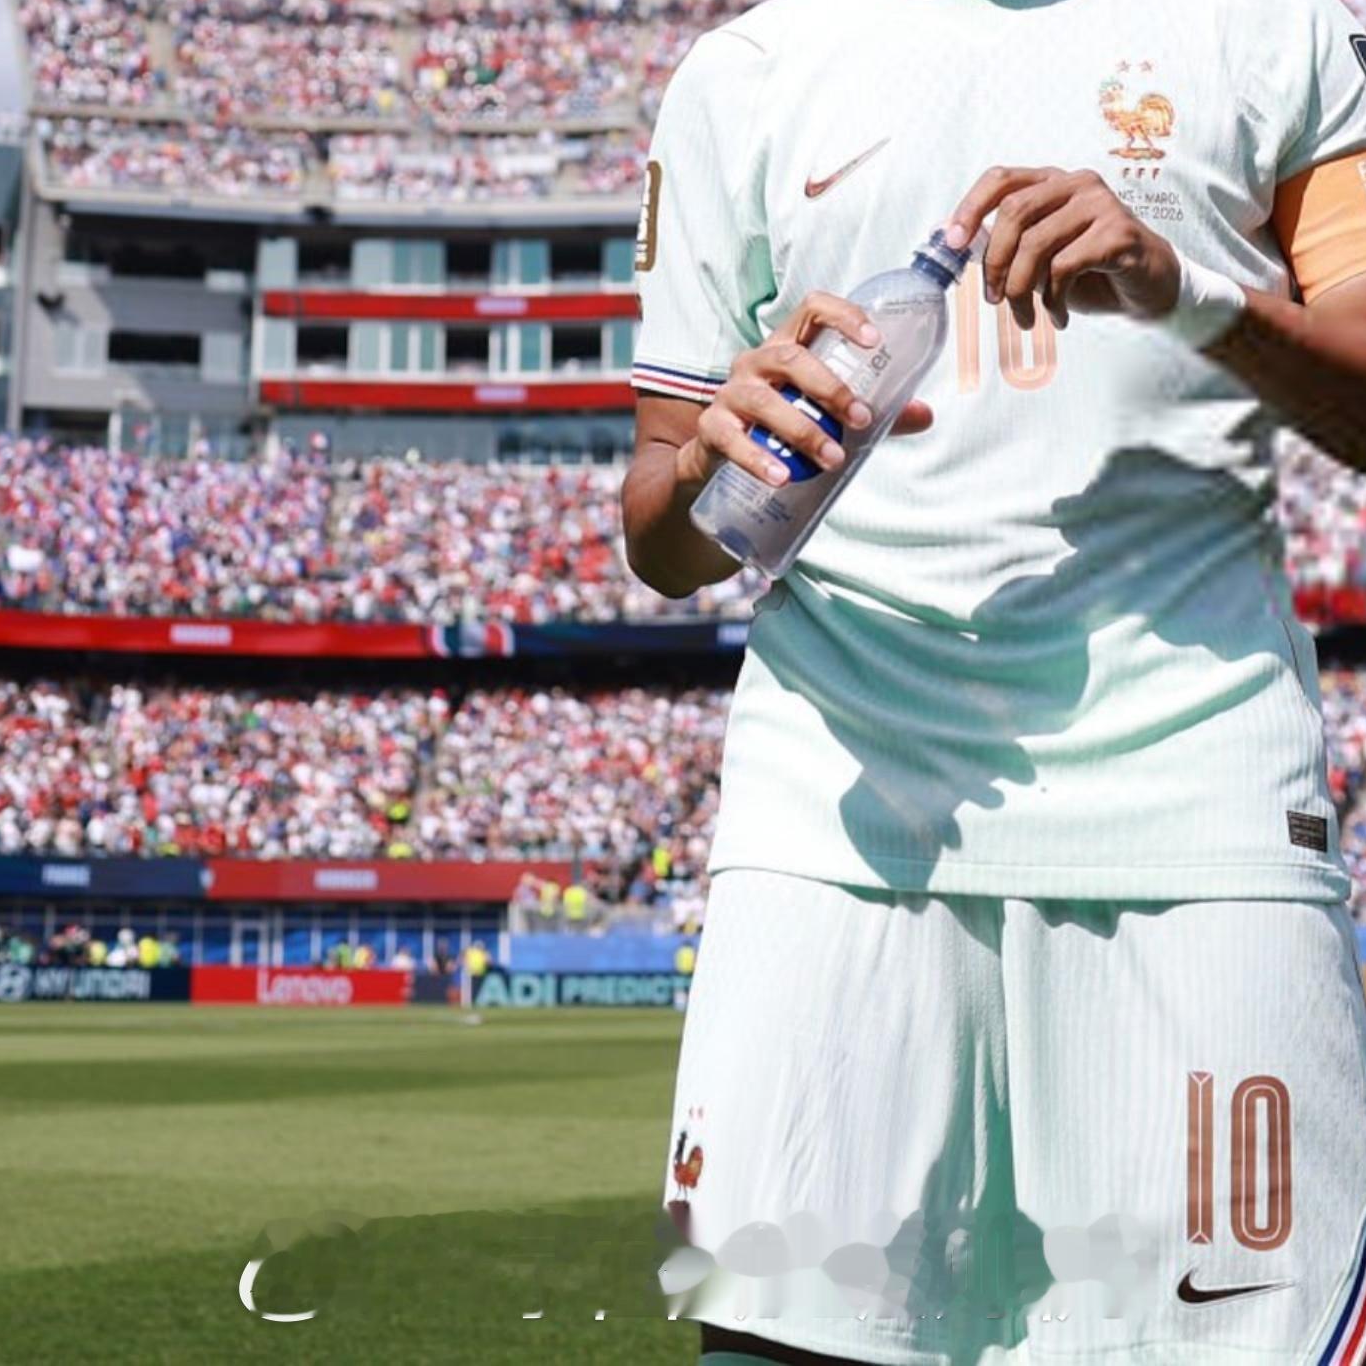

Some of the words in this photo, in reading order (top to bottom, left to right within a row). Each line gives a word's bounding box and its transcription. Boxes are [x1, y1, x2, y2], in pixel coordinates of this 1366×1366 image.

[1153, 205, 1184, 222] 2026
[35, 967, 152, 1000] HYUNDAI
[256, 968, 354, 1004] Lenovo
[475, 971, 556, 1008] ADI
[561, 973, 694, 1005] PREDICT
[1187, 1071, 1293, 1252] 10
